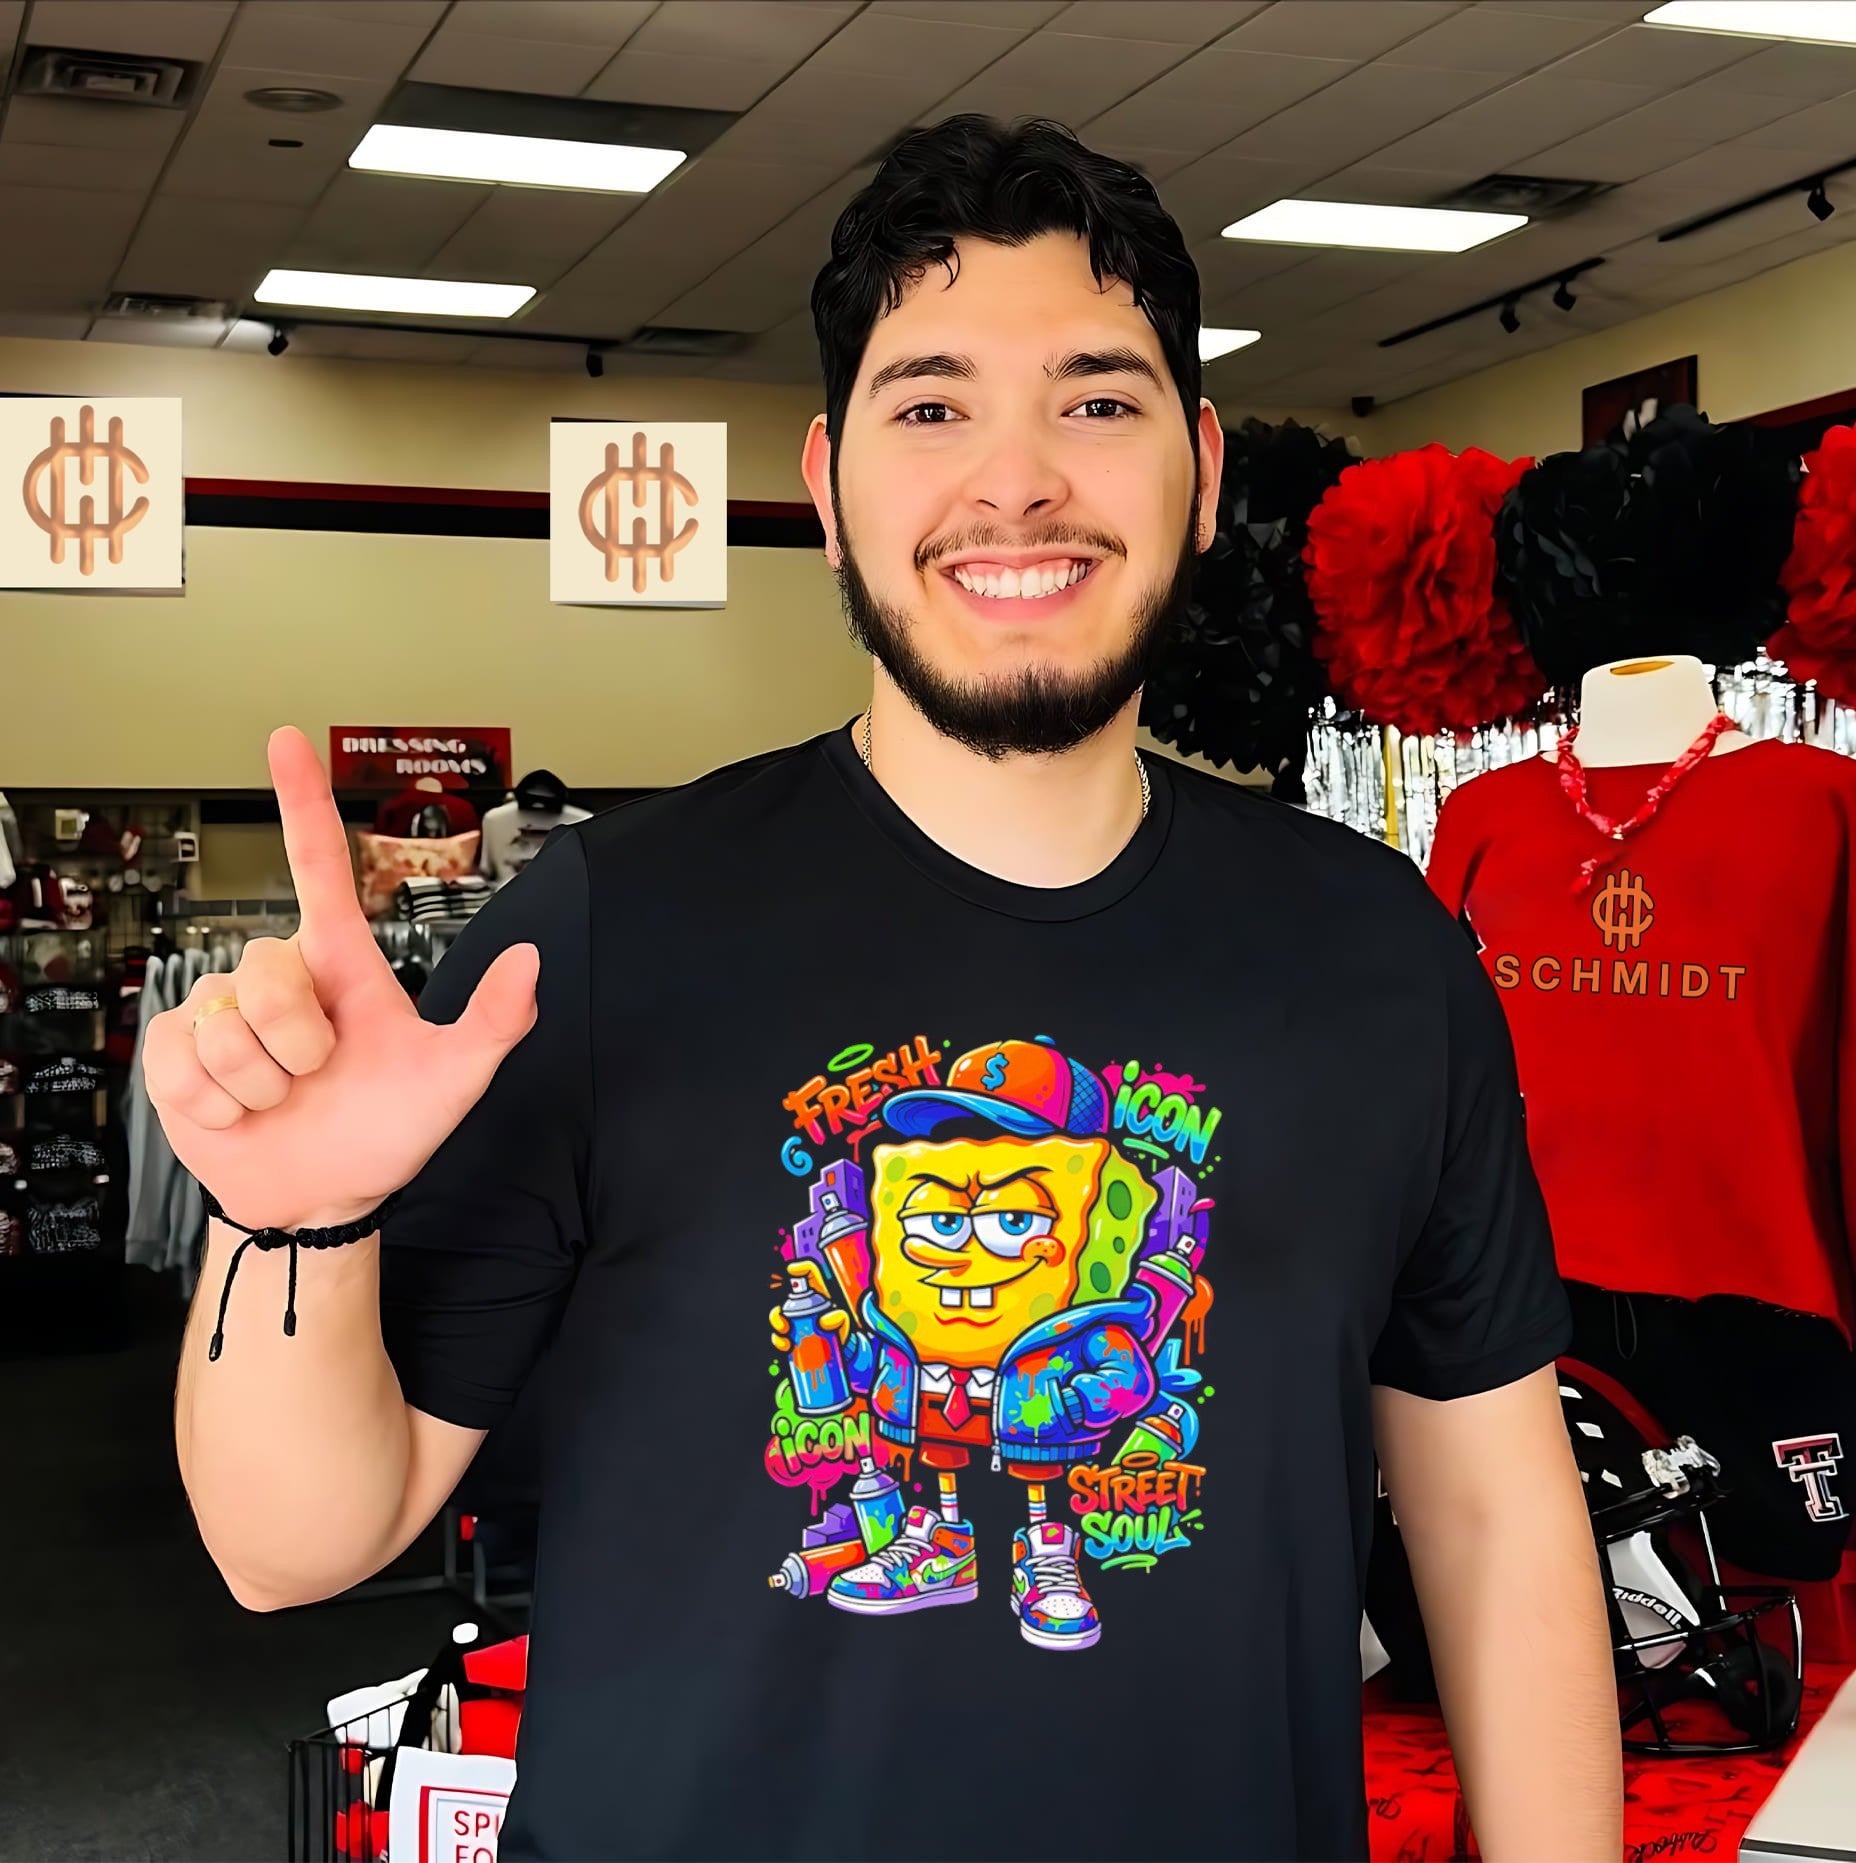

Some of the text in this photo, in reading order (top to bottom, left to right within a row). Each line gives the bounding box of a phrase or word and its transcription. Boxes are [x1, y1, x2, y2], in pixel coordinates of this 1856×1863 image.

[396, 758, 487, 775] ROOMS
[1494, 954, 1747, 1000] SCHMIDT
[782, 1034, 942, 1145] FRESH
[1067, 1461, 1206, 1514] STREET
[1081, 1506, 1191, 1559] SOUL
